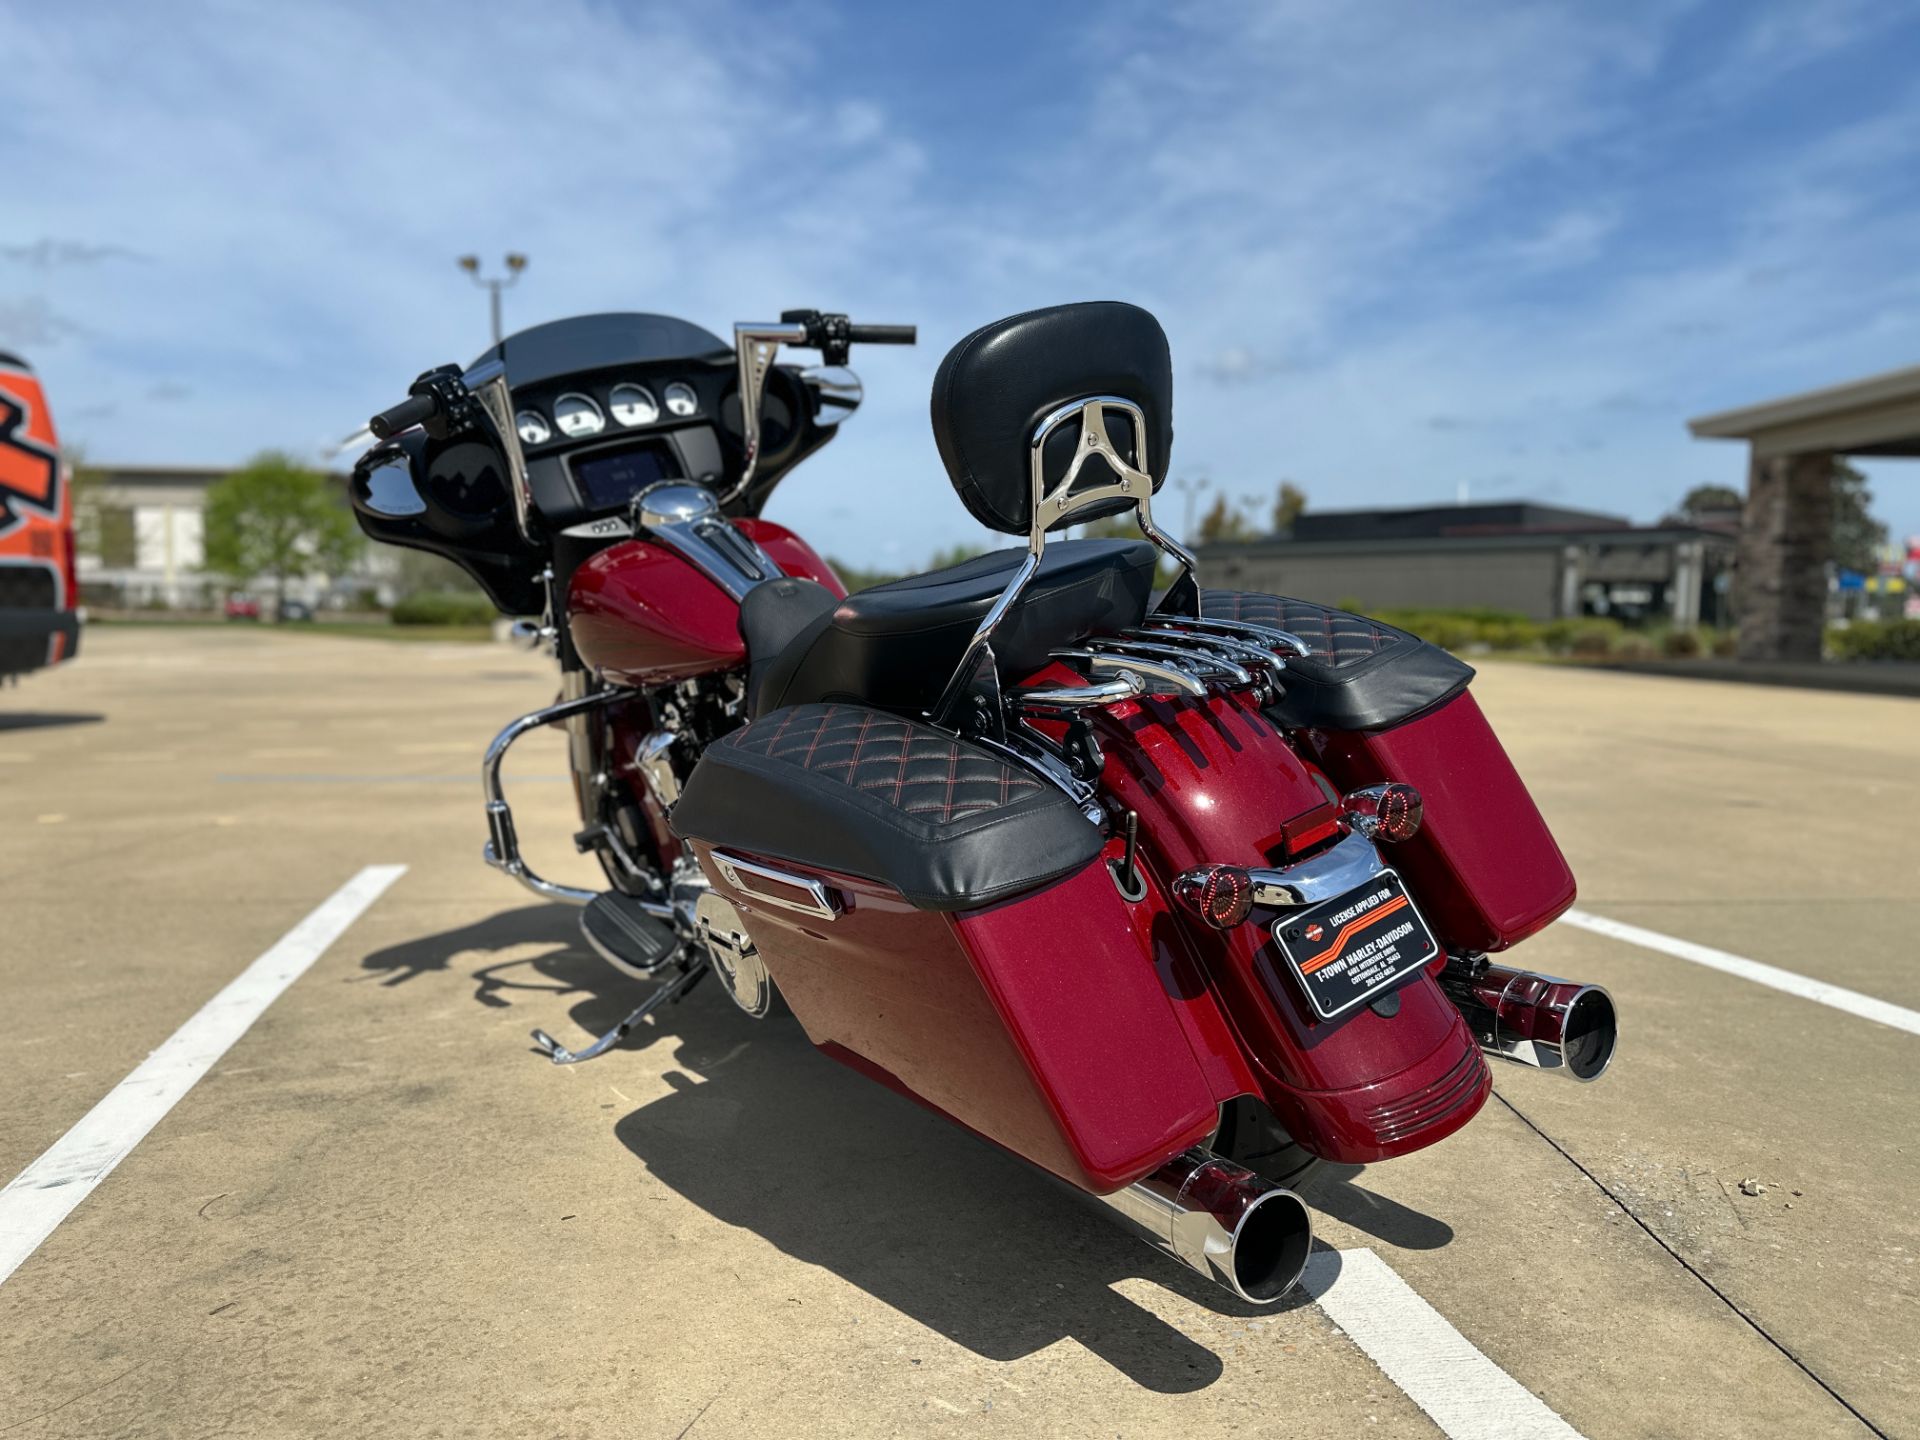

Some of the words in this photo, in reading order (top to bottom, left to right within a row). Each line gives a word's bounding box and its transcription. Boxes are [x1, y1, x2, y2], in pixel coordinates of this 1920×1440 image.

[1329, 906, 1357, 927] LICENSE
[1354, 894, 1380, 914] APPLIED
[1377, 888, 1392, 901] FOR
[1314, 958, 1348, 983] T-TOWN
[1345, 921, 1414, 966] HARLEY-DAVIDSON
